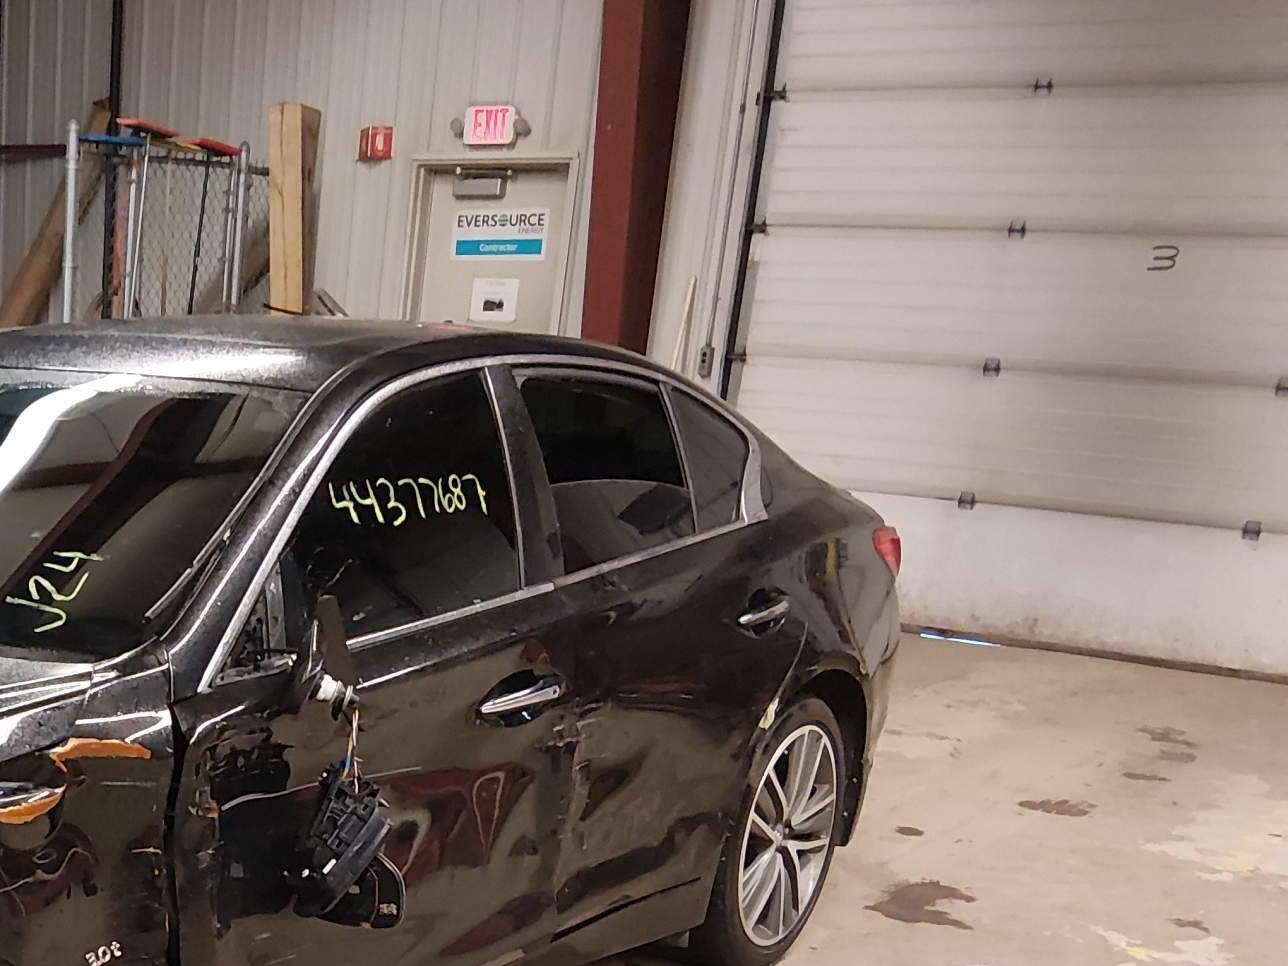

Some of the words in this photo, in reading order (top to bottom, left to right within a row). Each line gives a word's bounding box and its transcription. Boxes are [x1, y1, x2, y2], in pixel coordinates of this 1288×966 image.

[472, 108, 509, 141] EXIT
[479, 243, 518, 252] Contractor
[1146, 245, 1179, 271] 3
[328, 474, 488, 526] 44377687
